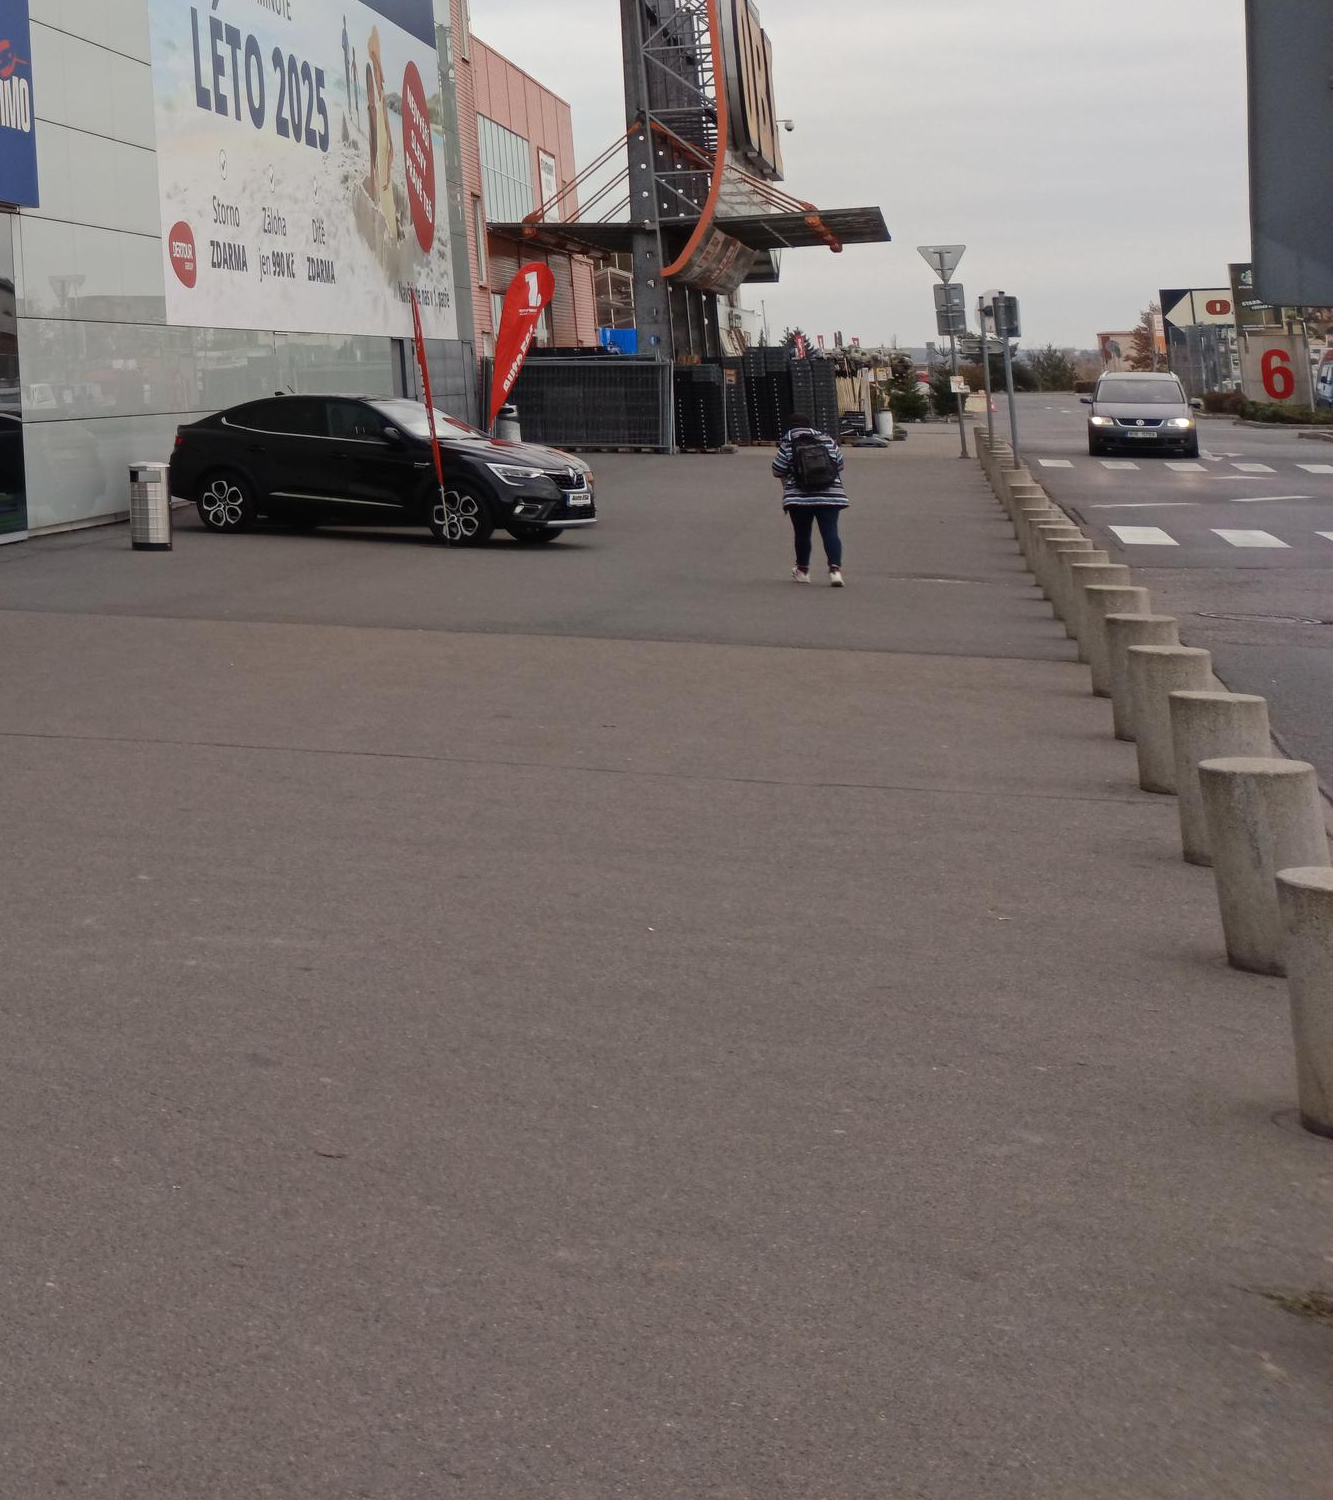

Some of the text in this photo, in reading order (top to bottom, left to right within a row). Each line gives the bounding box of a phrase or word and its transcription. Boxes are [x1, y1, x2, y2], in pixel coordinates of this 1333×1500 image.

[272, 47, 329, 153] 2025
[212, 196, 240, 227] Storno
[262, 207, 287, 237] Záloha
[312, 219, 326, 244] Dítě
[210, 240, 248, 272] ZDARMA
[259, 247, 295, 282] jen 990 Kč
[307, 256, 336, 284] ZDARMA
[1261, 349, 1295, 400] 6
